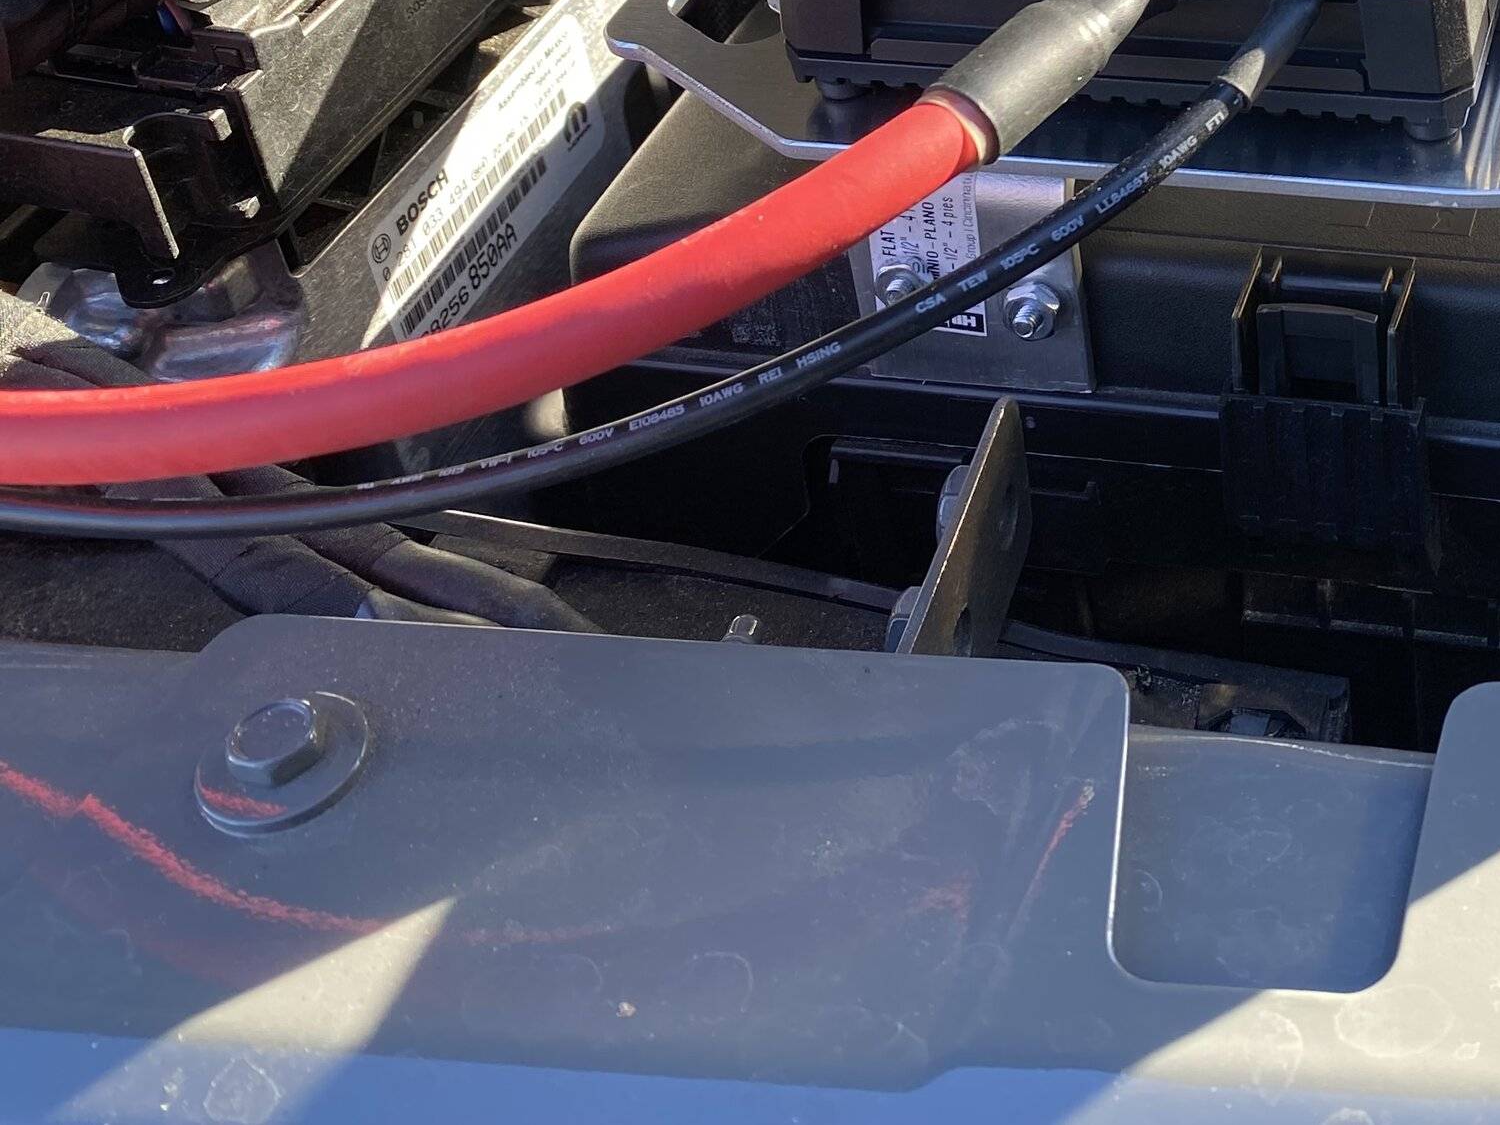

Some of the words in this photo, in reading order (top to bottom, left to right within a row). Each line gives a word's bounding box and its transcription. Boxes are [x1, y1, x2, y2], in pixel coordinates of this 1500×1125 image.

[396, 168, 449, 236] BOSCH
[943, 196, 958, 219] pies
[880, 229, 897, 257] FLAT
[420, 285, 470, 338] 8256
[468, 222, 518, 290] 850AA
[579, 426, 615, 446] 600V
[699, 382, 744, 408] 10AWG
[758, 366, 784, 385] REI
[795, 340, 841, 370] HSING
[915, 293, 947, 314] CSA
[957, 269, 989, 292] TEW
[1050, 214, 1085, 242] 600V
[1158, 134, 1199, 169] 10AWG
[1205, 111, 1225, 132] FT1
